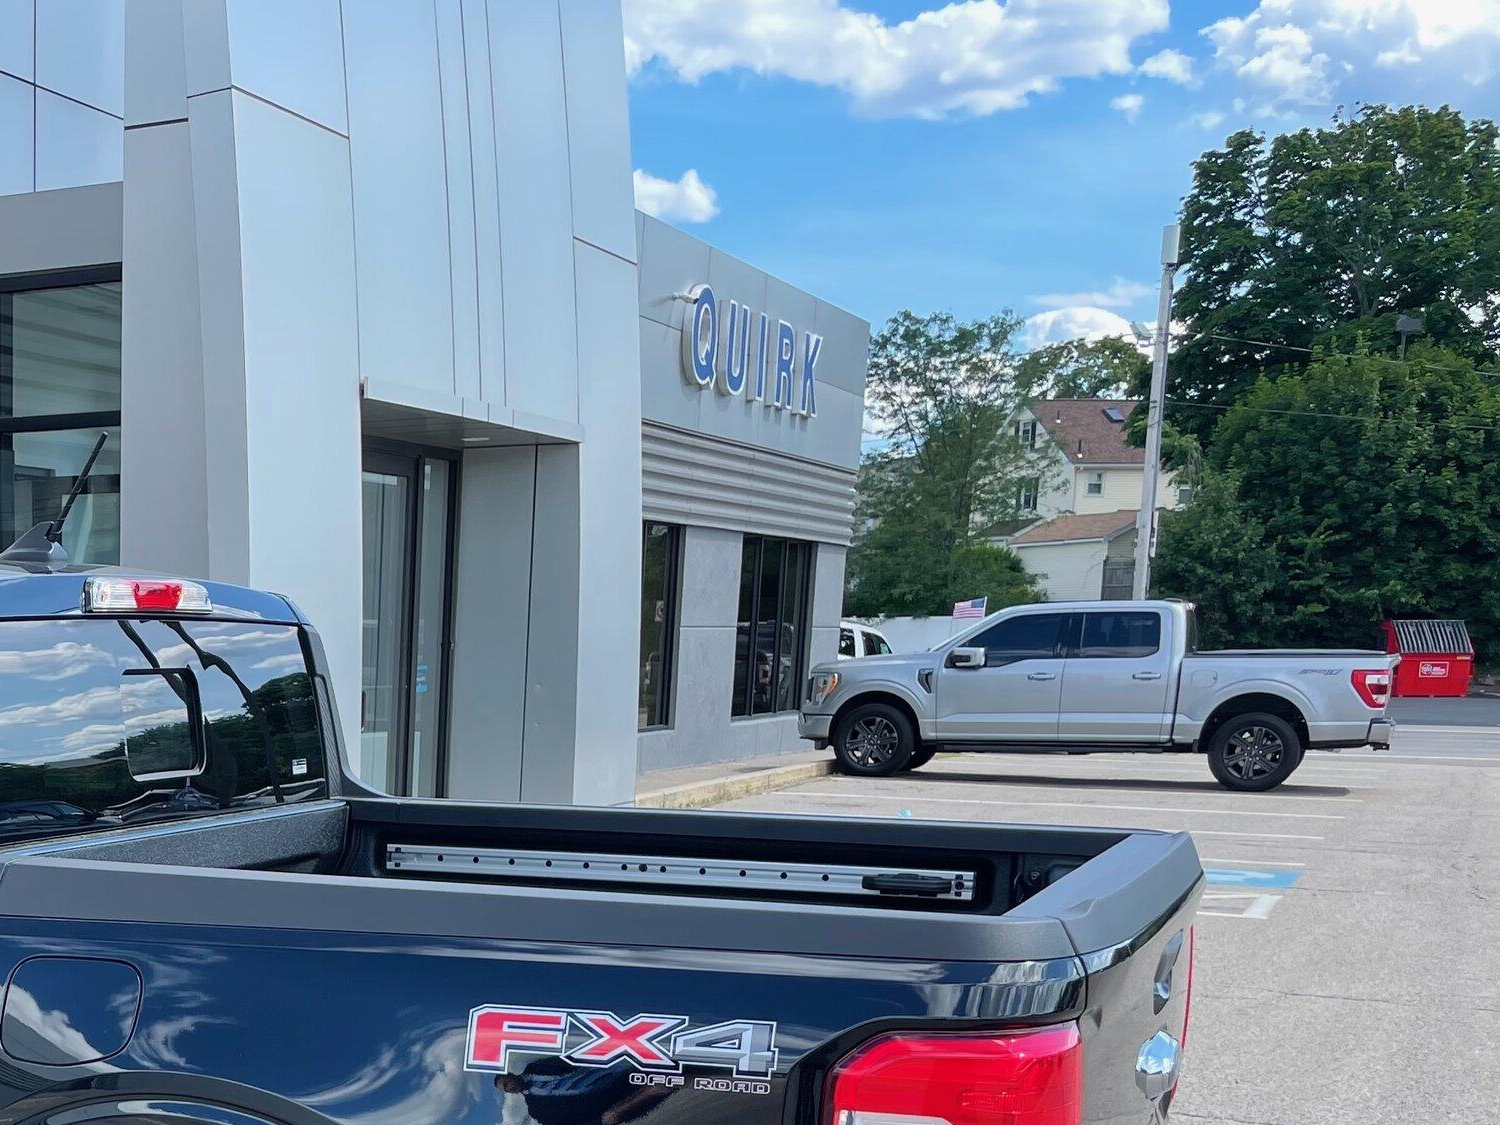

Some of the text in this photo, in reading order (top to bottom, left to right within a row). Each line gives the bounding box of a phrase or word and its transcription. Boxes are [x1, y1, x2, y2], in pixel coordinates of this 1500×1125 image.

[684, 283, 823, 418] QUIRK
[463, 1003, 779, 1080] FX4
[629, 1073, 771, 1095] OFF ROAD
